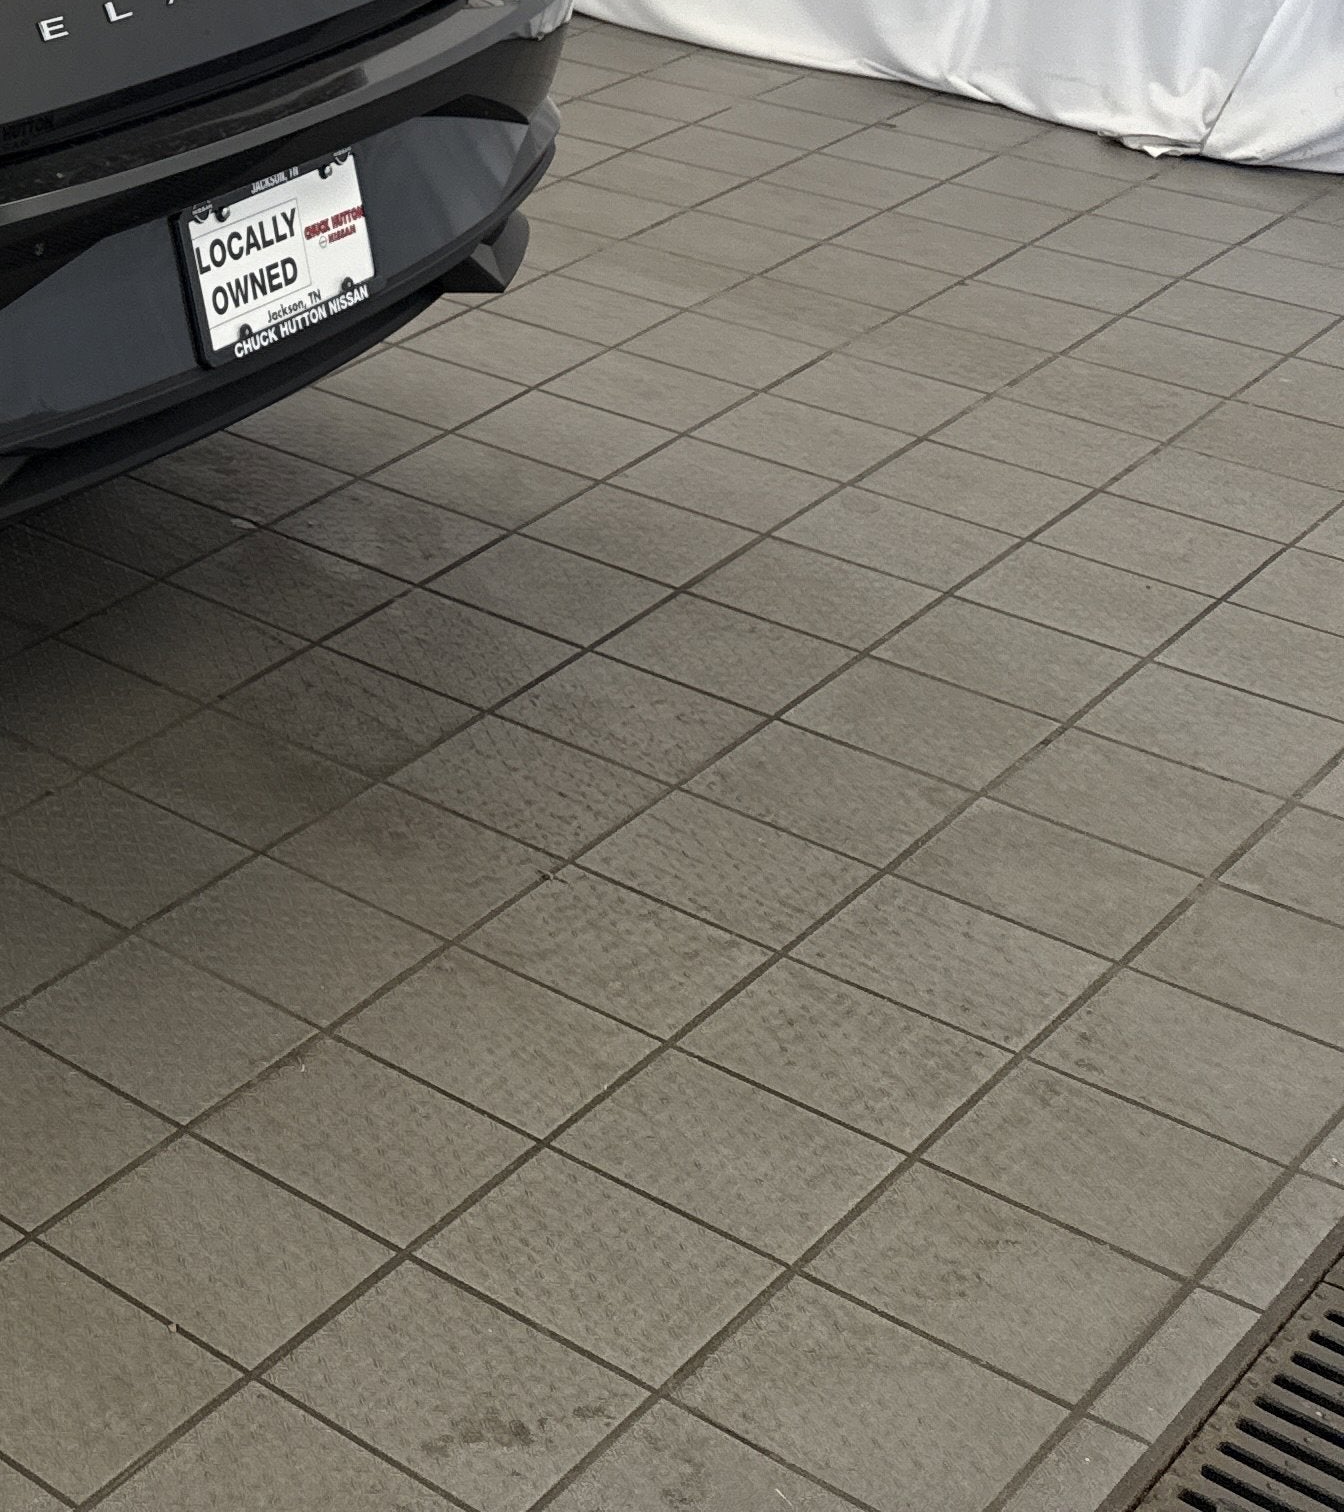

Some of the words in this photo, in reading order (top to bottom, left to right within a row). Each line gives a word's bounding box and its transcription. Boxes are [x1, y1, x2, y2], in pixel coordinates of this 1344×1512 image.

[196, 207, 297, 275] LOCALLY
[212, 257, 298, 315] OWNED
[267, 299, 307, 324] Jackson,
[308, 289, 322, 306] TN
[234, 326, 279, 358] CHUCK
[279, 306, 327, 337] HUTTON
[328, 286, 369, 317] NISSAN
